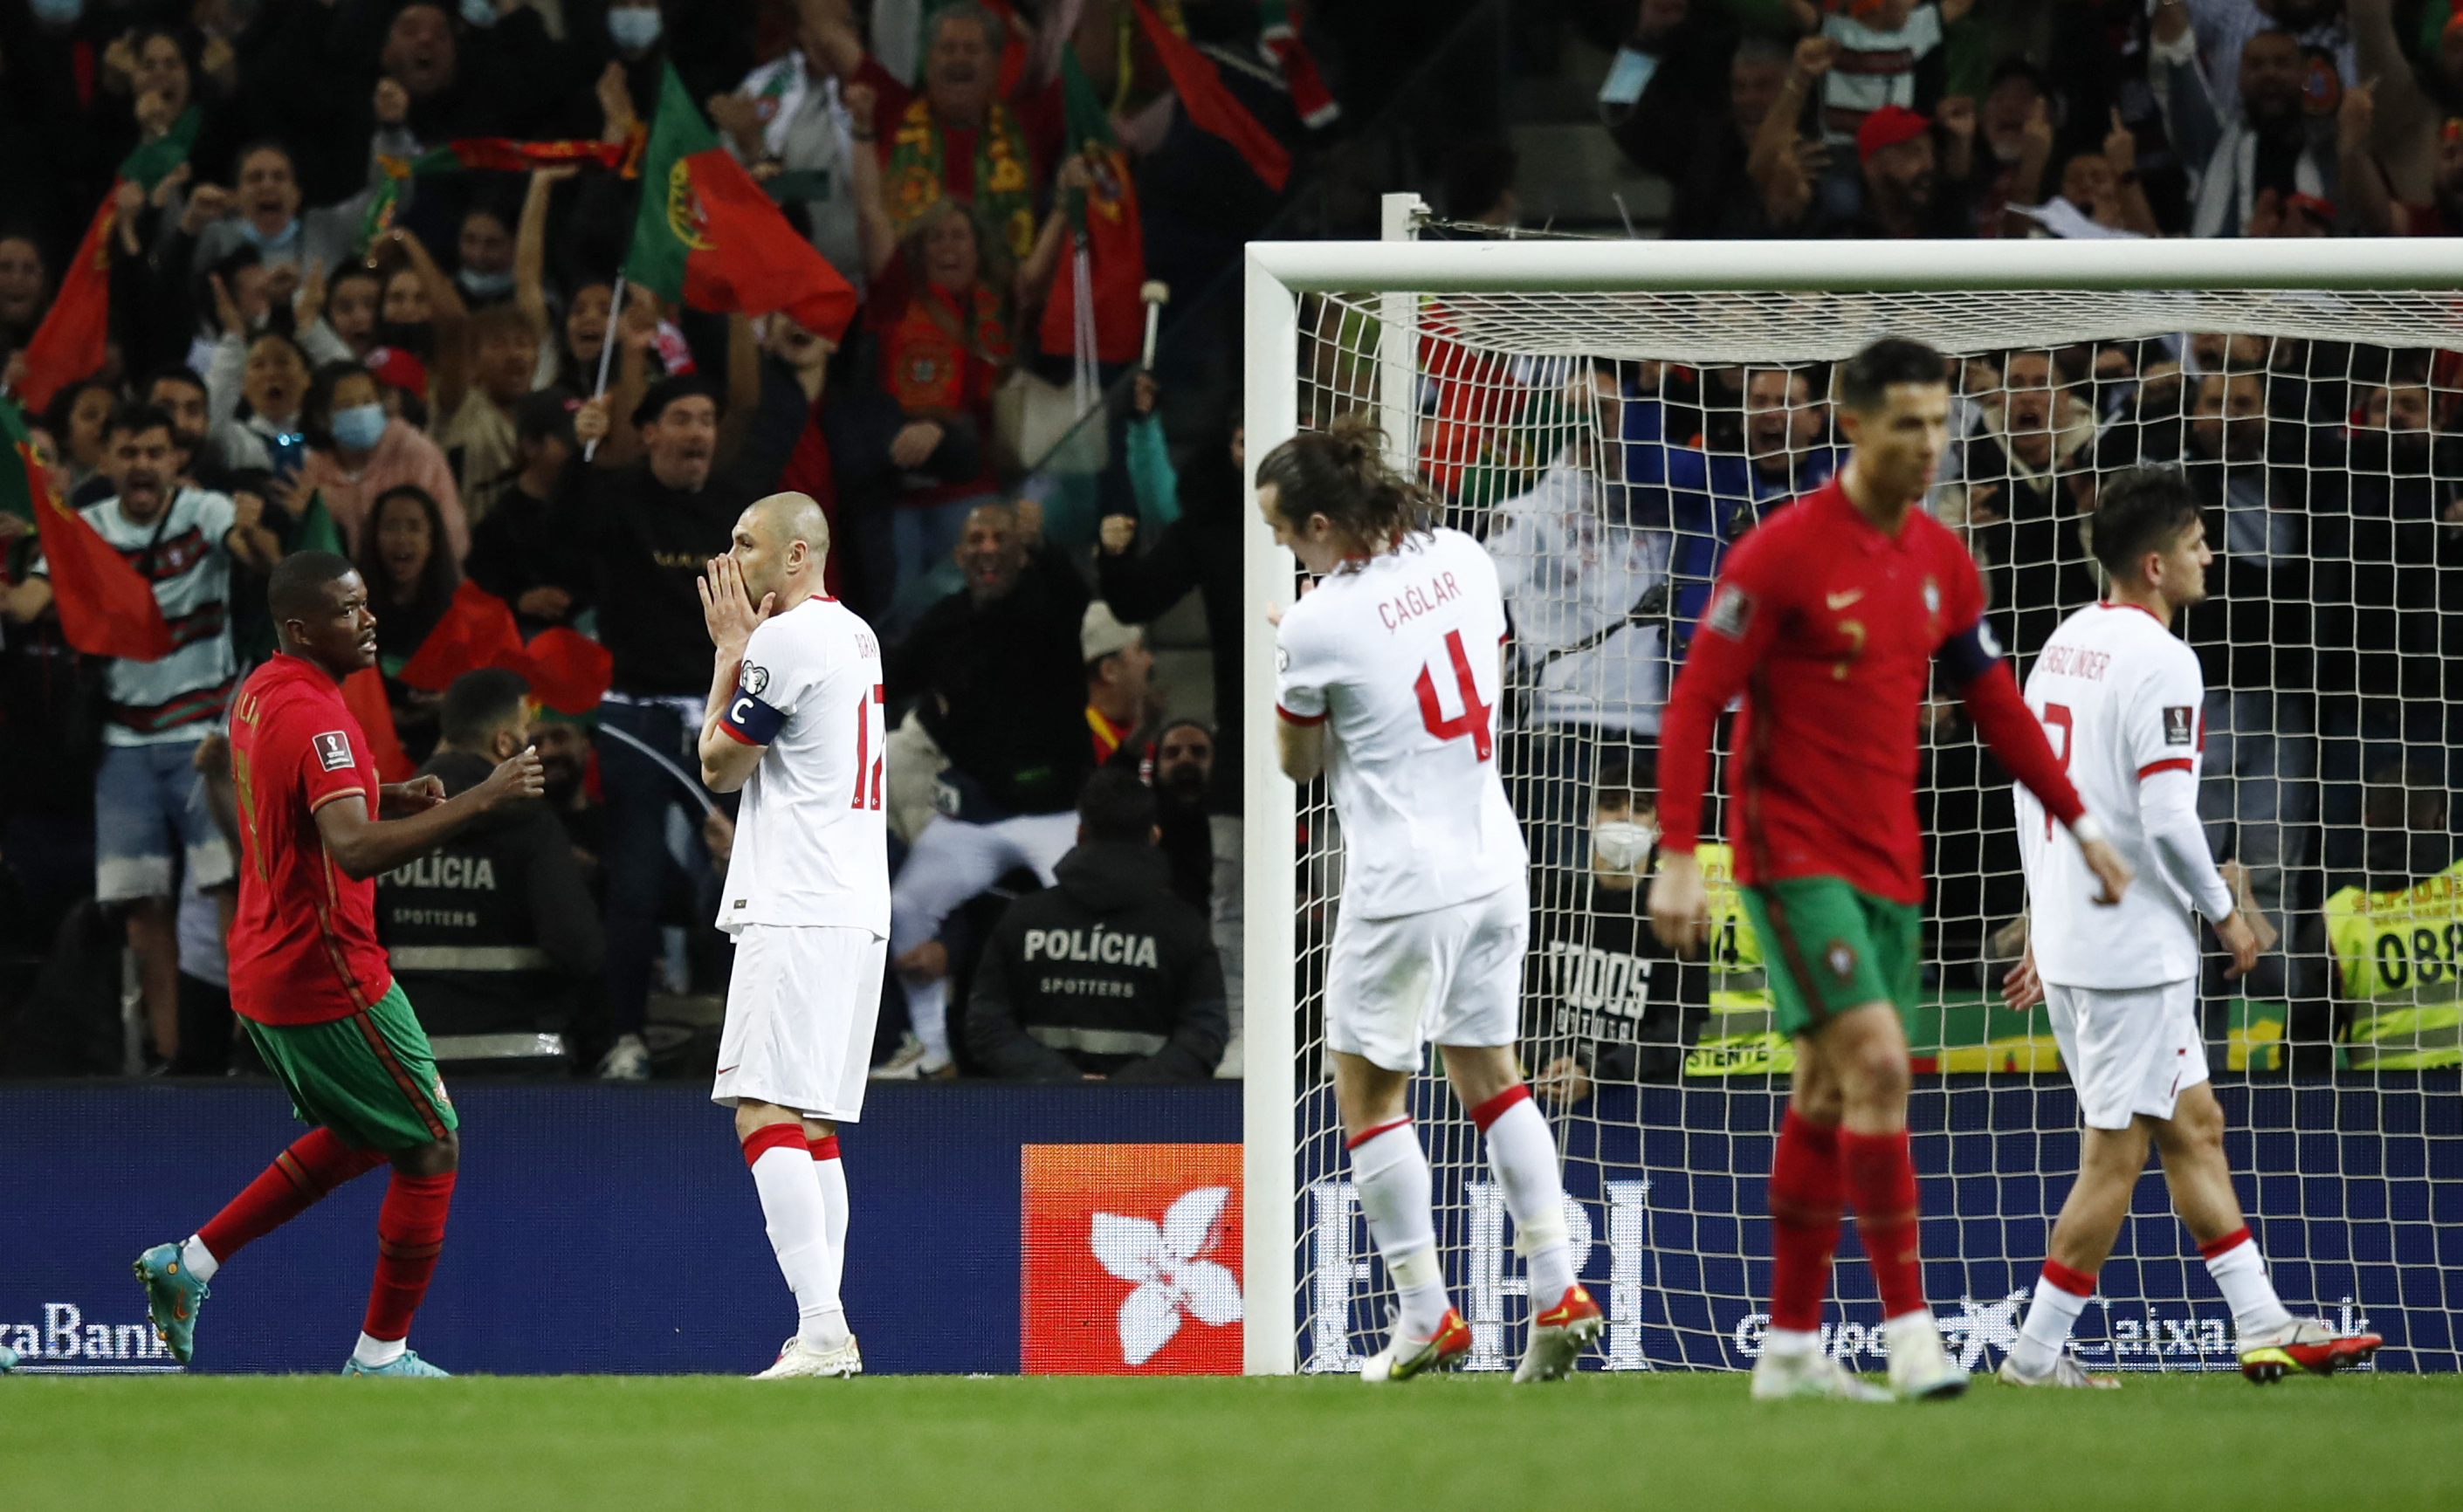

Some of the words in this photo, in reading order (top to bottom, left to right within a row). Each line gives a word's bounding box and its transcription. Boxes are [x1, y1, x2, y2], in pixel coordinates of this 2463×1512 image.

[1378, 571, 1462, 635] ÇAĞLAR
[731, 698, 754, 725] C
[1413, 628, 1492, 763] 4
[851, 684, 885, 811] 17
[393, 909, 478, 927] SPOTTERS
[1023, 922, 1159, 970] POLÍCIA
[1040, 978, 1134, 998] SPOTTERS
